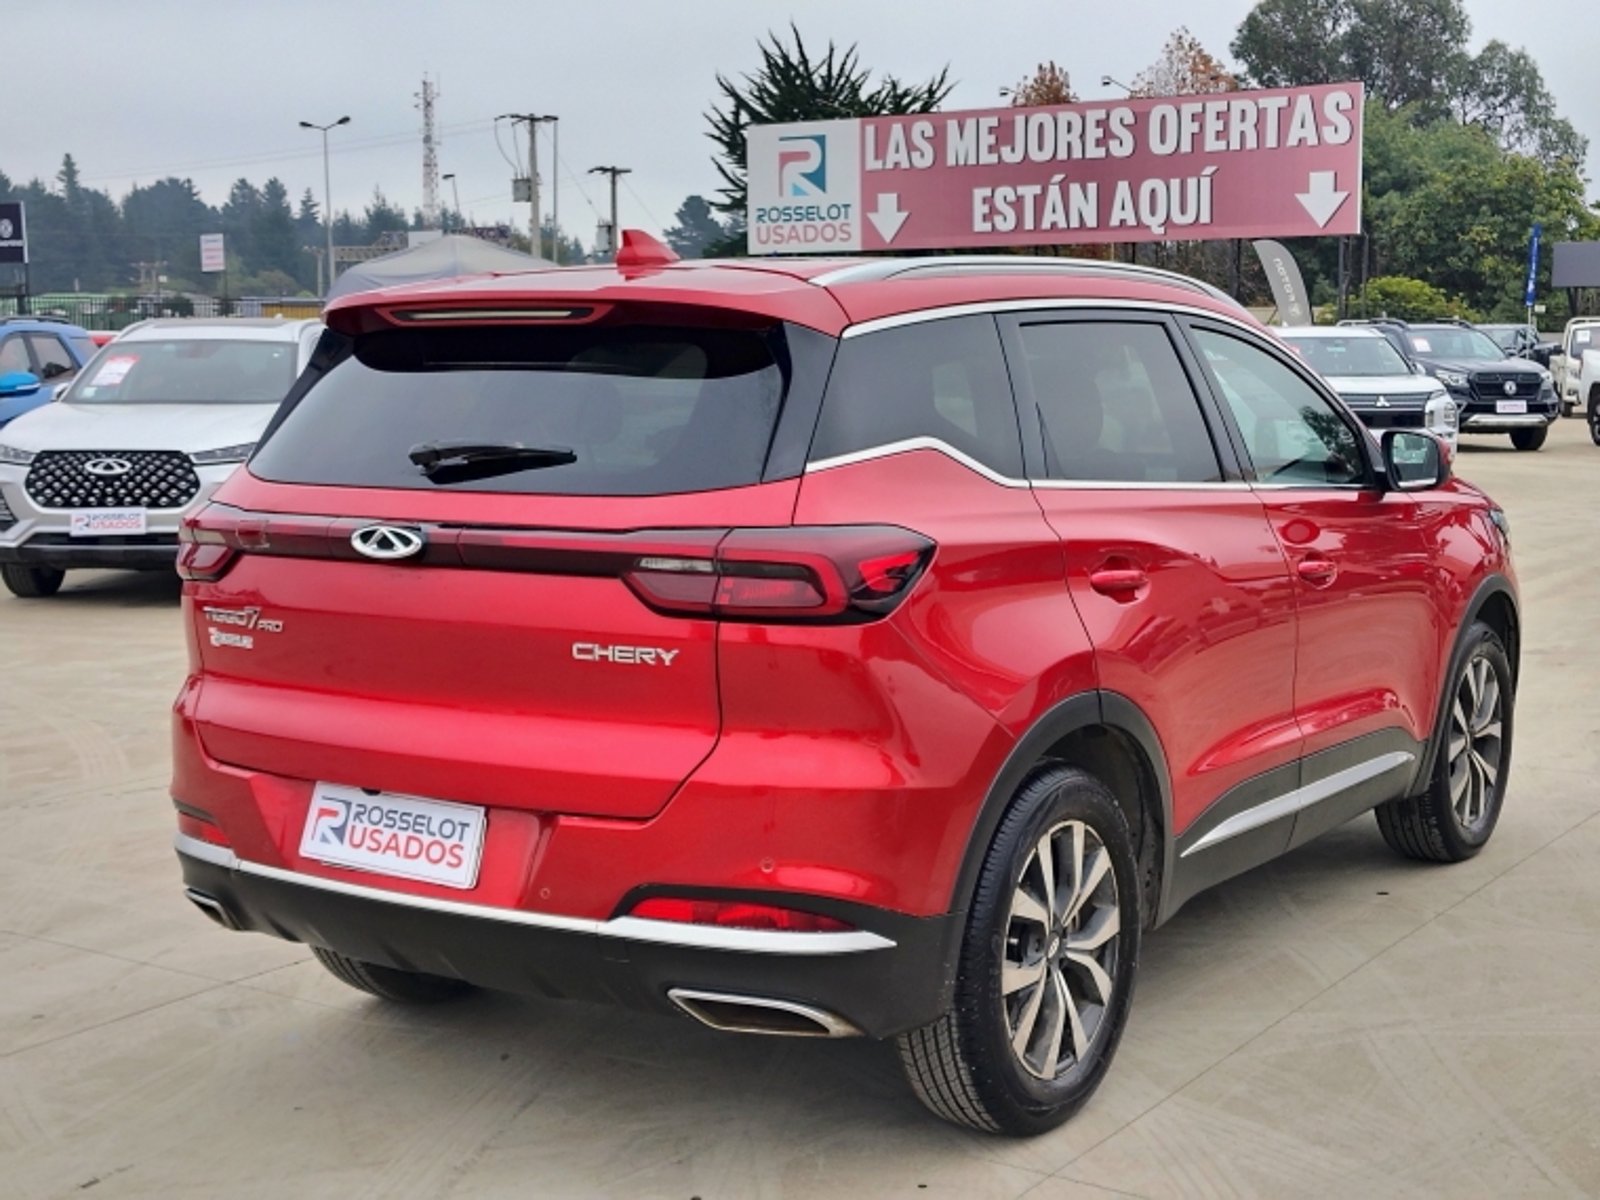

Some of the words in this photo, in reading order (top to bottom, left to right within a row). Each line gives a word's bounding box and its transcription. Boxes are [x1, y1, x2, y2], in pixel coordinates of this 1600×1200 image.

[865, 120, 935, 171] LAS
[946, 106, 1136, 167] MEJORES
[1149, 90, 1354, 156] OFERTAS
[755, 203, 852, 224] ROSSELOT
[972, 173, 1098, 233] ESTÁN
[1109, 165, 1219, 235] AQUÍ
[756, 222, 852, 245] USADOS
[571, 642, 680, 667] CHERY
[352, 803, 471, 843] ROSSELOT
[348, 825, 465, 869] USADOS
